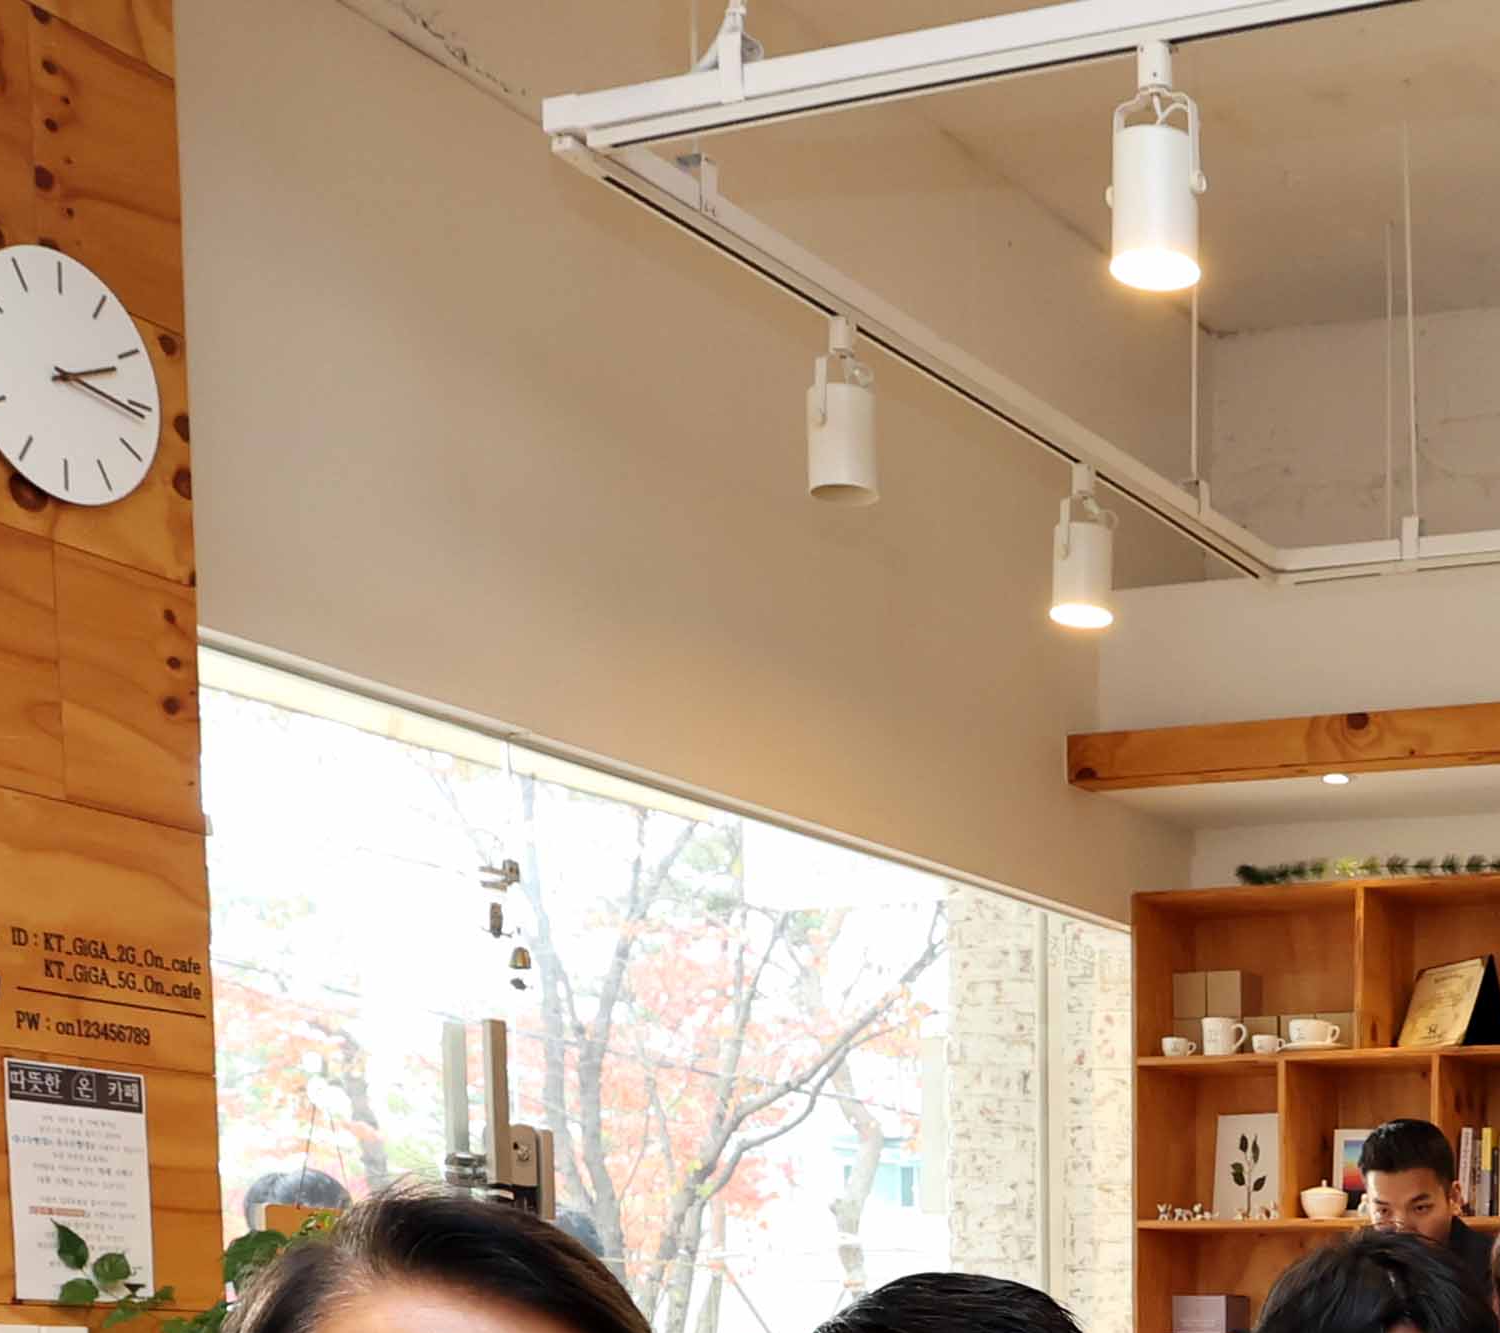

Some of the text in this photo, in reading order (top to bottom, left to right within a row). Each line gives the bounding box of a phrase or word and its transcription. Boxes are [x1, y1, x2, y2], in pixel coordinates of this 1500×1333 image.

[11, 926, 29, 946] ID
[15, 1010, 41, 1031] PW
[9, 1069, 140, 1103] 따뜻한 온 카페
